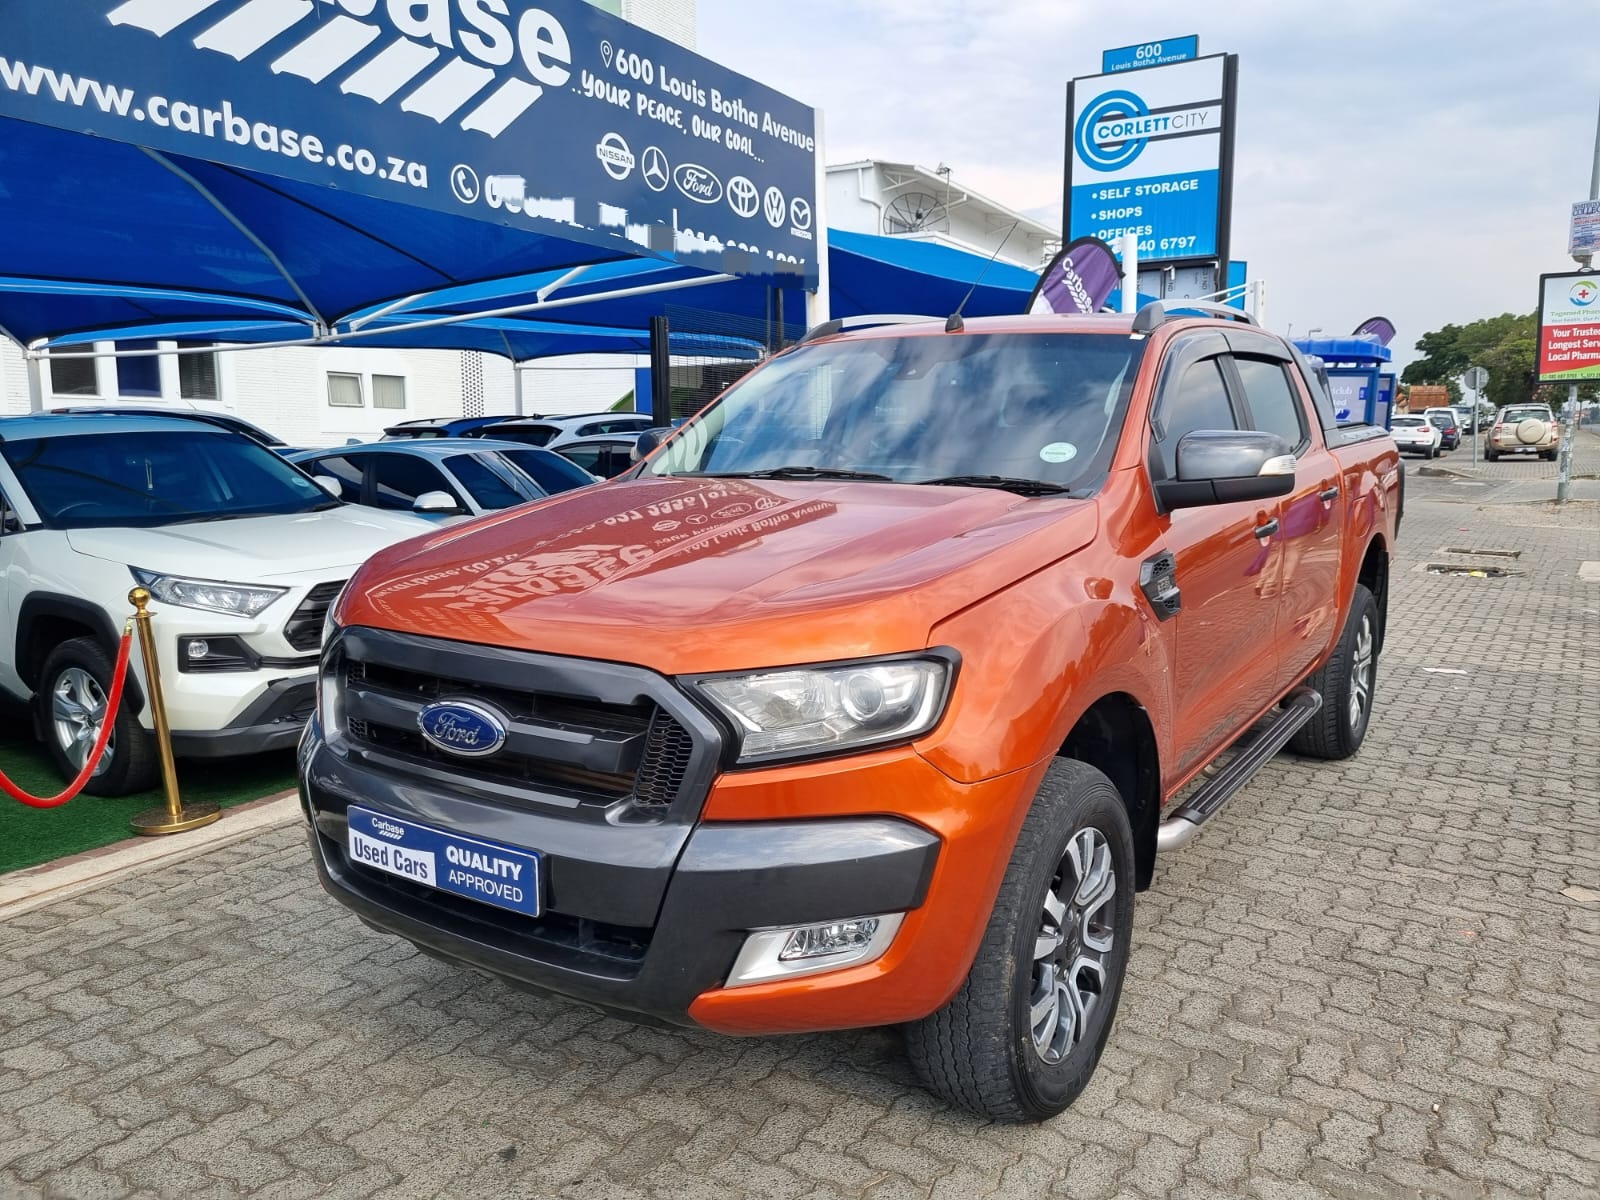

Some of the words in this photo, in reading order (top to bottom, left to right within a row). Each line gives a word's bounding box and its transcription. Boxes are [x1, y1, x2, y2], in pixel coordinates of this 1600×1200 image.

[336, 0, 571, 87] ase
[1136, 43, 1162, 60] 600
[1111, 62, 1131, 71] Louis
[1132, 58, 1155, 68] Botha
[1157, 53, 1187, 64] Avenue
[615, 48, 654, 85] 600
[659, 65, 706, 107] Louis
[710, 88, 758, 129] Botha
[762, 112, 814, 152] Avenue
[0, 57, 429, 189] www.carbase.co.za
[636, 92, 687, 135] PEACE,
[691, 114, 722, 144] OUR
[598, 144, 634, 166] NISSAN
[683, 169, 713, 197] Ford
[1099, 187, 1131, 200] SELF
[1135, 179, 1199, 196] STORAGE
[1098, 206, 1143, 220] SHOPS
[1098, 225, 1153, 239] OFFICES
[1138, 240, 1156, 252] 40
[1160, 236, 1196, 250] 6797
[1552, 328, 1571, 338] Your
[1548, 339, 1581, 351] Longest
[1547, 352, 1570, 361] Local
[433, 711, 482, 746] Ford
[371, 817, 405, 836] Carbase
[353, 836, 389, 866] Used
[393, 849, 428, 879] Cars
[446, 845, 522, 881] QUALITY
[448, 869, 523, 902] APPROVED
